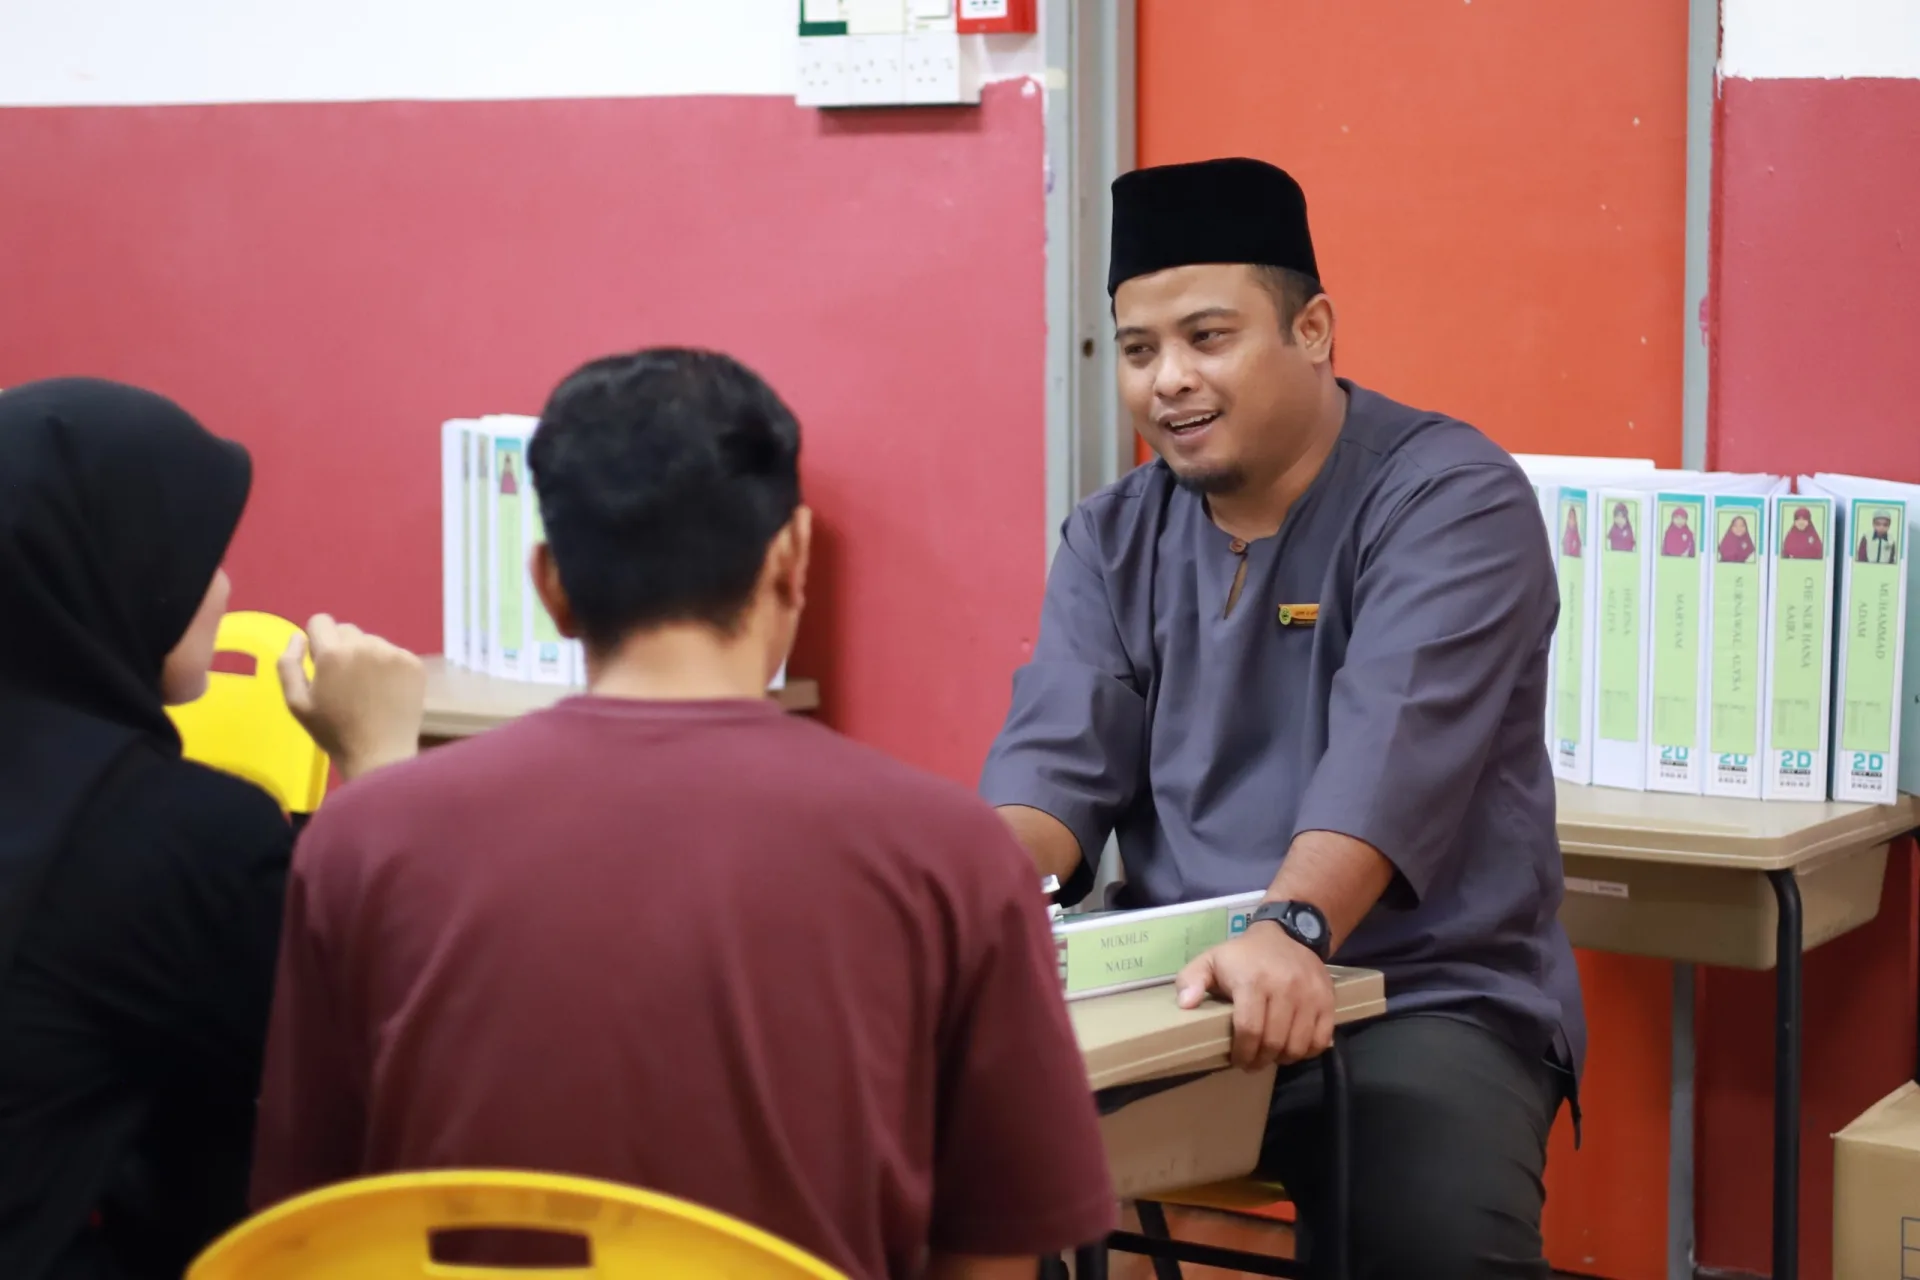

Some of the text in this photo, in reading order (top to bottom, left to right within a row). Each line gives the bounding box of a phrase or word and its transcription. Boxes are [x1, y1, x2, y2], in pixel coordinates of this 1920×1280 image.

[1674, 593, 1686, 650] MARYAM
[1800, 577, 1815, 668] CHE NUR HANA
[1857, 600, 1869, 638] ADAM
[1875, 582, 1890, 660] MUHAMMAD
[1781, 750, 1812, 768] 2D
[1852, 752, 1883, 770] 2D
[1100, 930, 1150, 950] MUKHLIS
[1105, 957, 1144, 973] NAEEM
